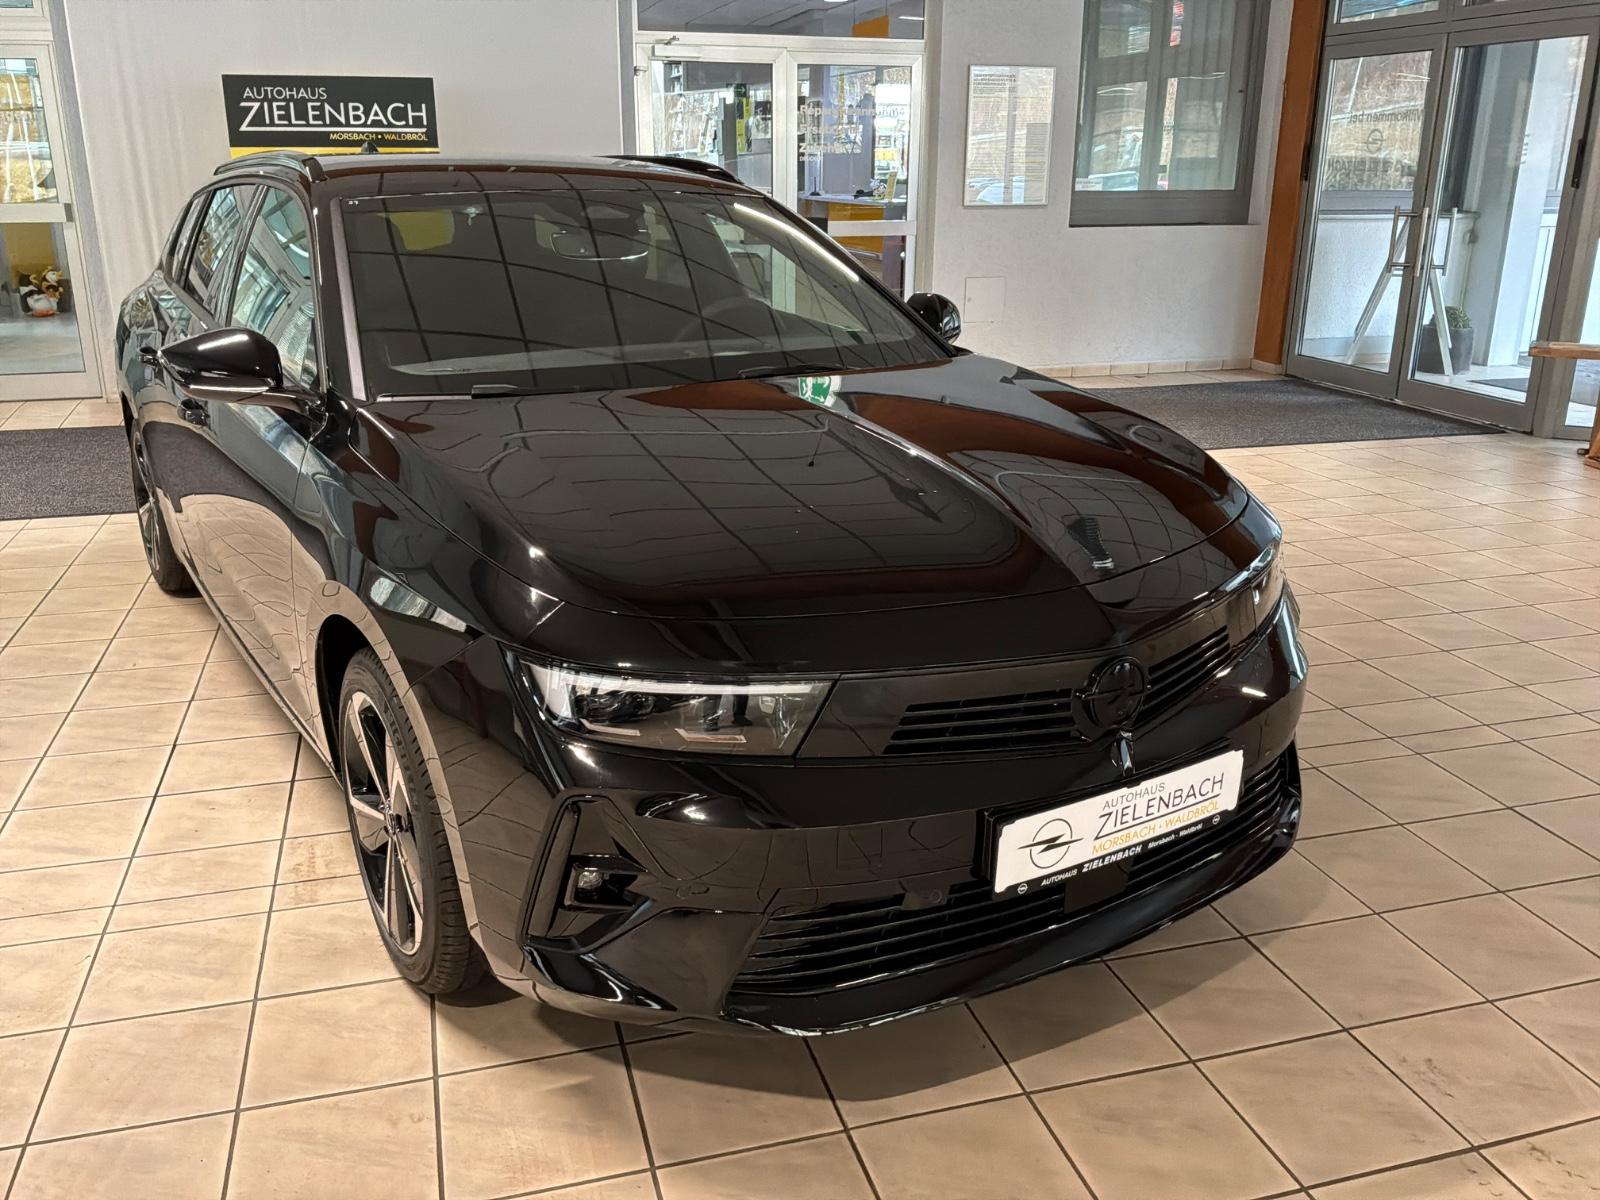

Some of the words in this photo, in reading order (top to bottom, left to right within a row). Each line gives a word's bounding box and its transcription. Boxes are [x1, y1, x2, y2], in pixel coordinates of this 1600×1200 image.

[243, 87, 327, 100] AUTOHAUS
[239, 102, 428, 131] ZIELENBACH
[329, 132, 376, 141] MORSBACH
[383, 132, 428, 141] WALDBRÖL
[1094, 772, 1224, 840] ZIELENBACH
[1103, 782, 1166, 811] AUTOHAUS
[1092, 823, 1157, 855] MORSBACH
[1165, 799, 1219, 829] WALDBRÖL
[1041, 869, 1077, 887] AUTOHAUS
[1082, 845, 1142, 873] ZIELENBACH
